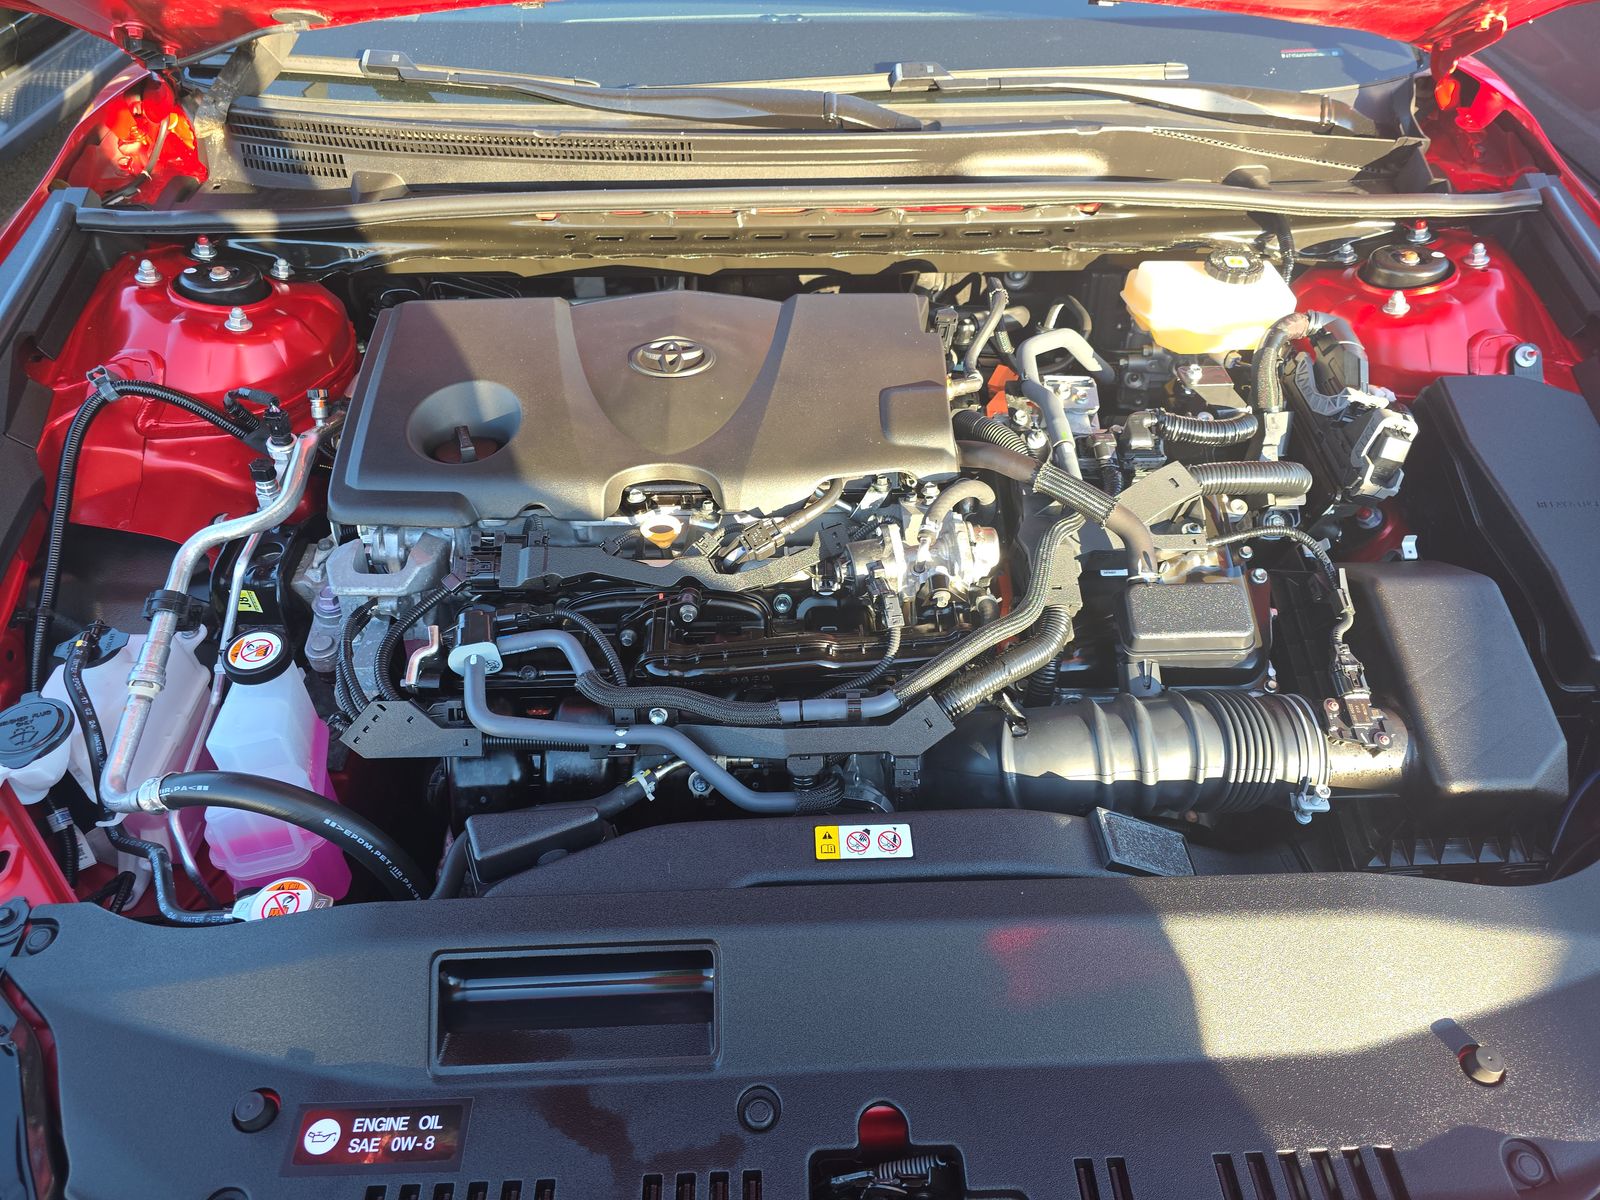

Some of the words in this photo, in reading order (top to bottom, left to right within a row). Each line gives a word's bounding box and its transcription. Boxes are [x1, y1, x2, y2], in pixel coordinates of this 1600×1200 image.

[352, 1116, 410, 1133] ENGINE
[418, 1115, 443, 1130] OIL
[347, 1137, 381, 1154] SAE
[390, 1135, 436, 1152] 0W-8
